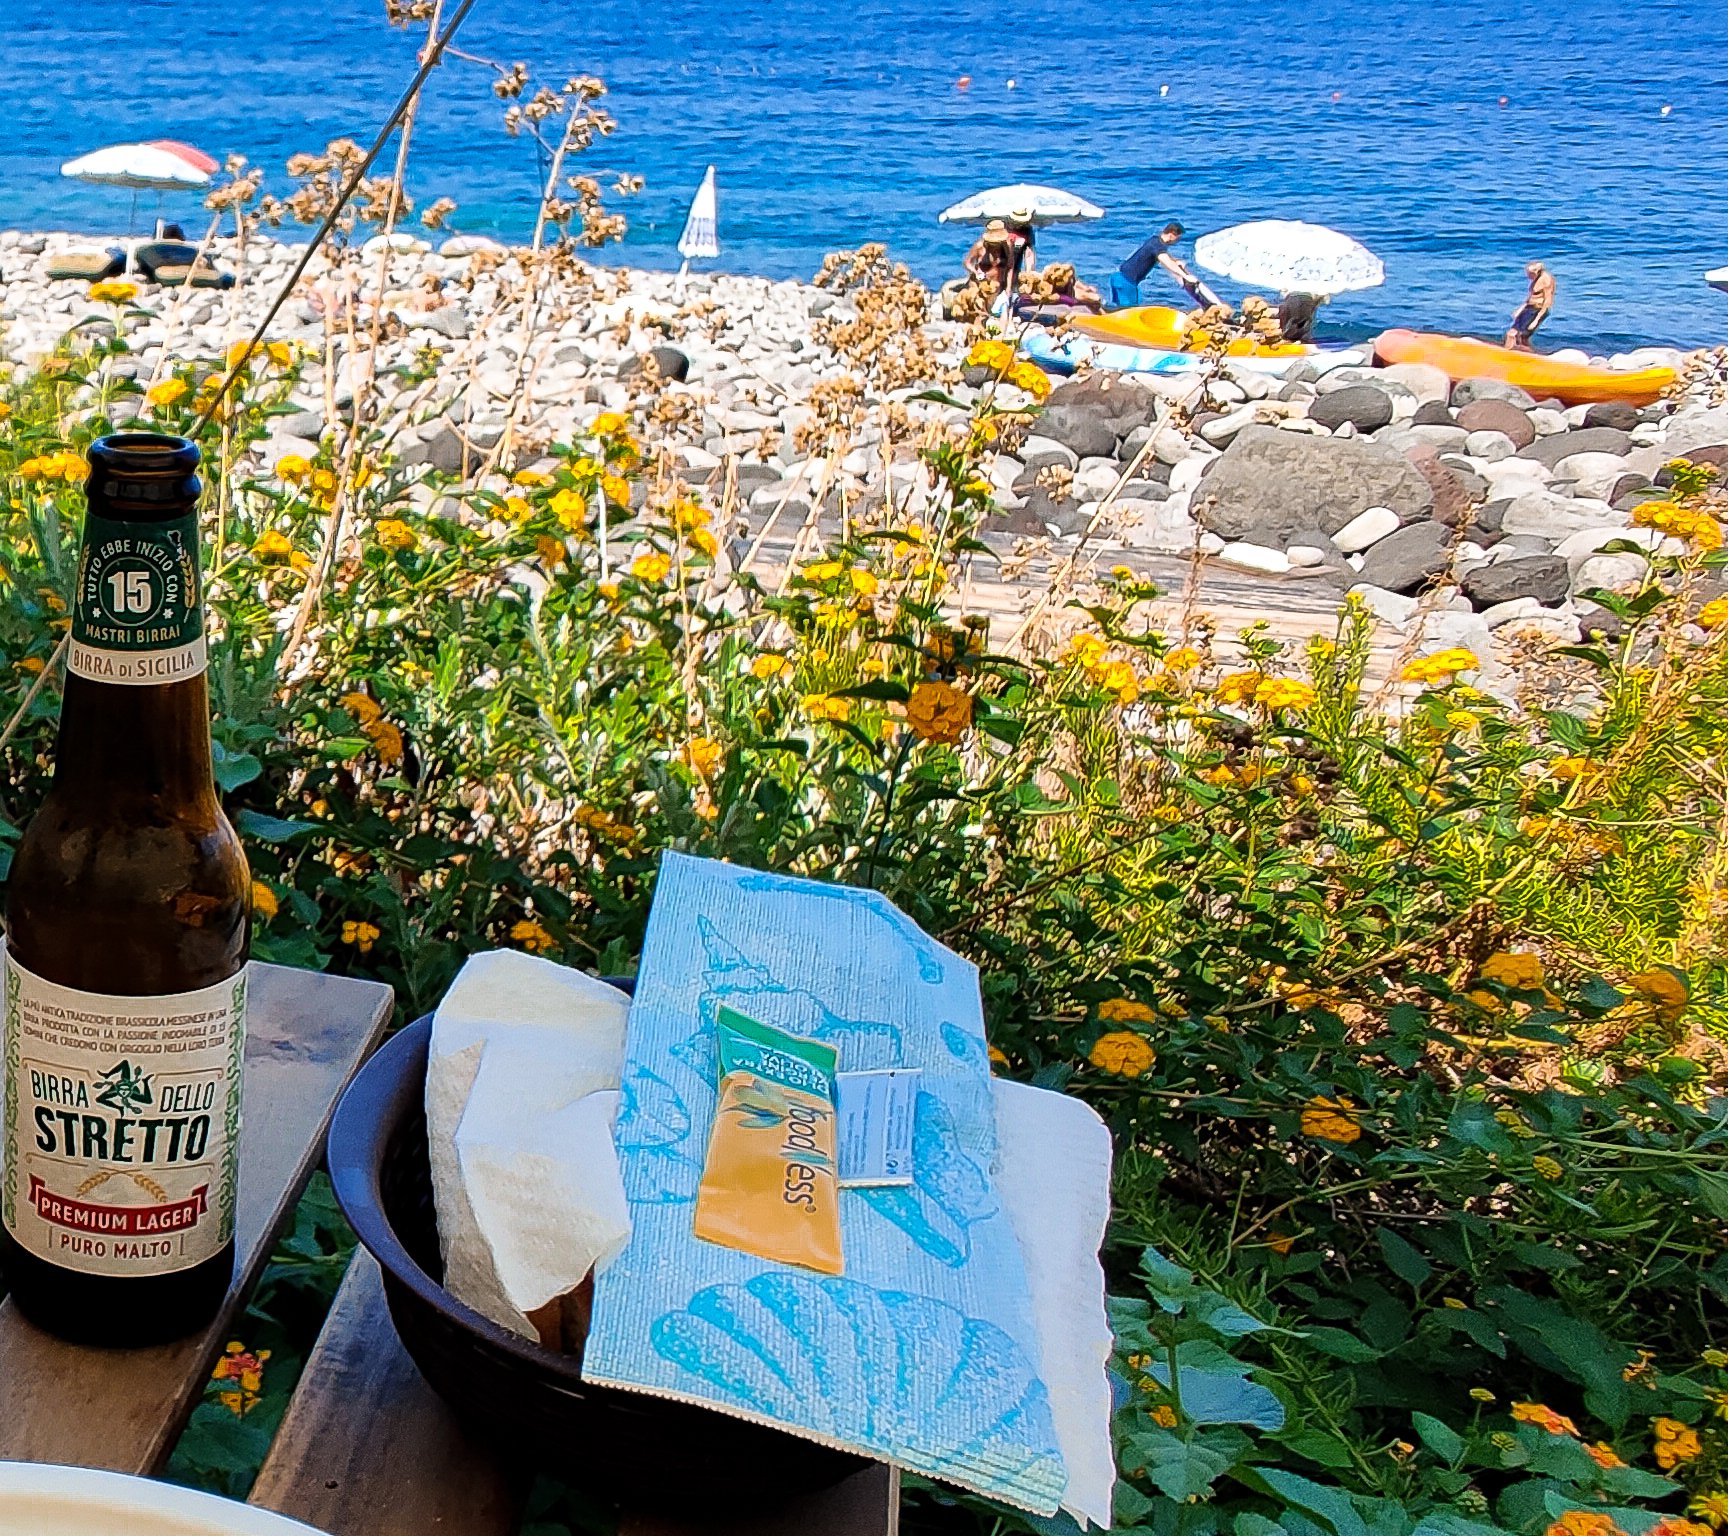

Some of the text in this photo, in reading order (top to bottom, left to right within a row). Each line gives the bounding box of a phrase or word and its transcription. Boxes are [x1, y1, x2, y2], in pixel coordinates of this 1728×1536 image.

[87, 539, 179, 604] TUTTO EBBE INIZIO CON
[107, 570, 152, 614] 15
[85, 624, 181, 644] MASTRI BIRRAI
[73, 648, 195, 678] BIRRA DI SICILIA
[41, 1018, 80, 1035] PRODOTTA
[82, 1026, 100, 1037] CON
[103, 1028, 114, 1039] LA
[31, 1068, 216, 1113] BIRRA DELLO
[34, 1105, 212, 1164] STRETTO
[40, 1197, 193, 1231] PREMIUM LAGER
[60, 1233, 172, 1259] PURO MALTO
